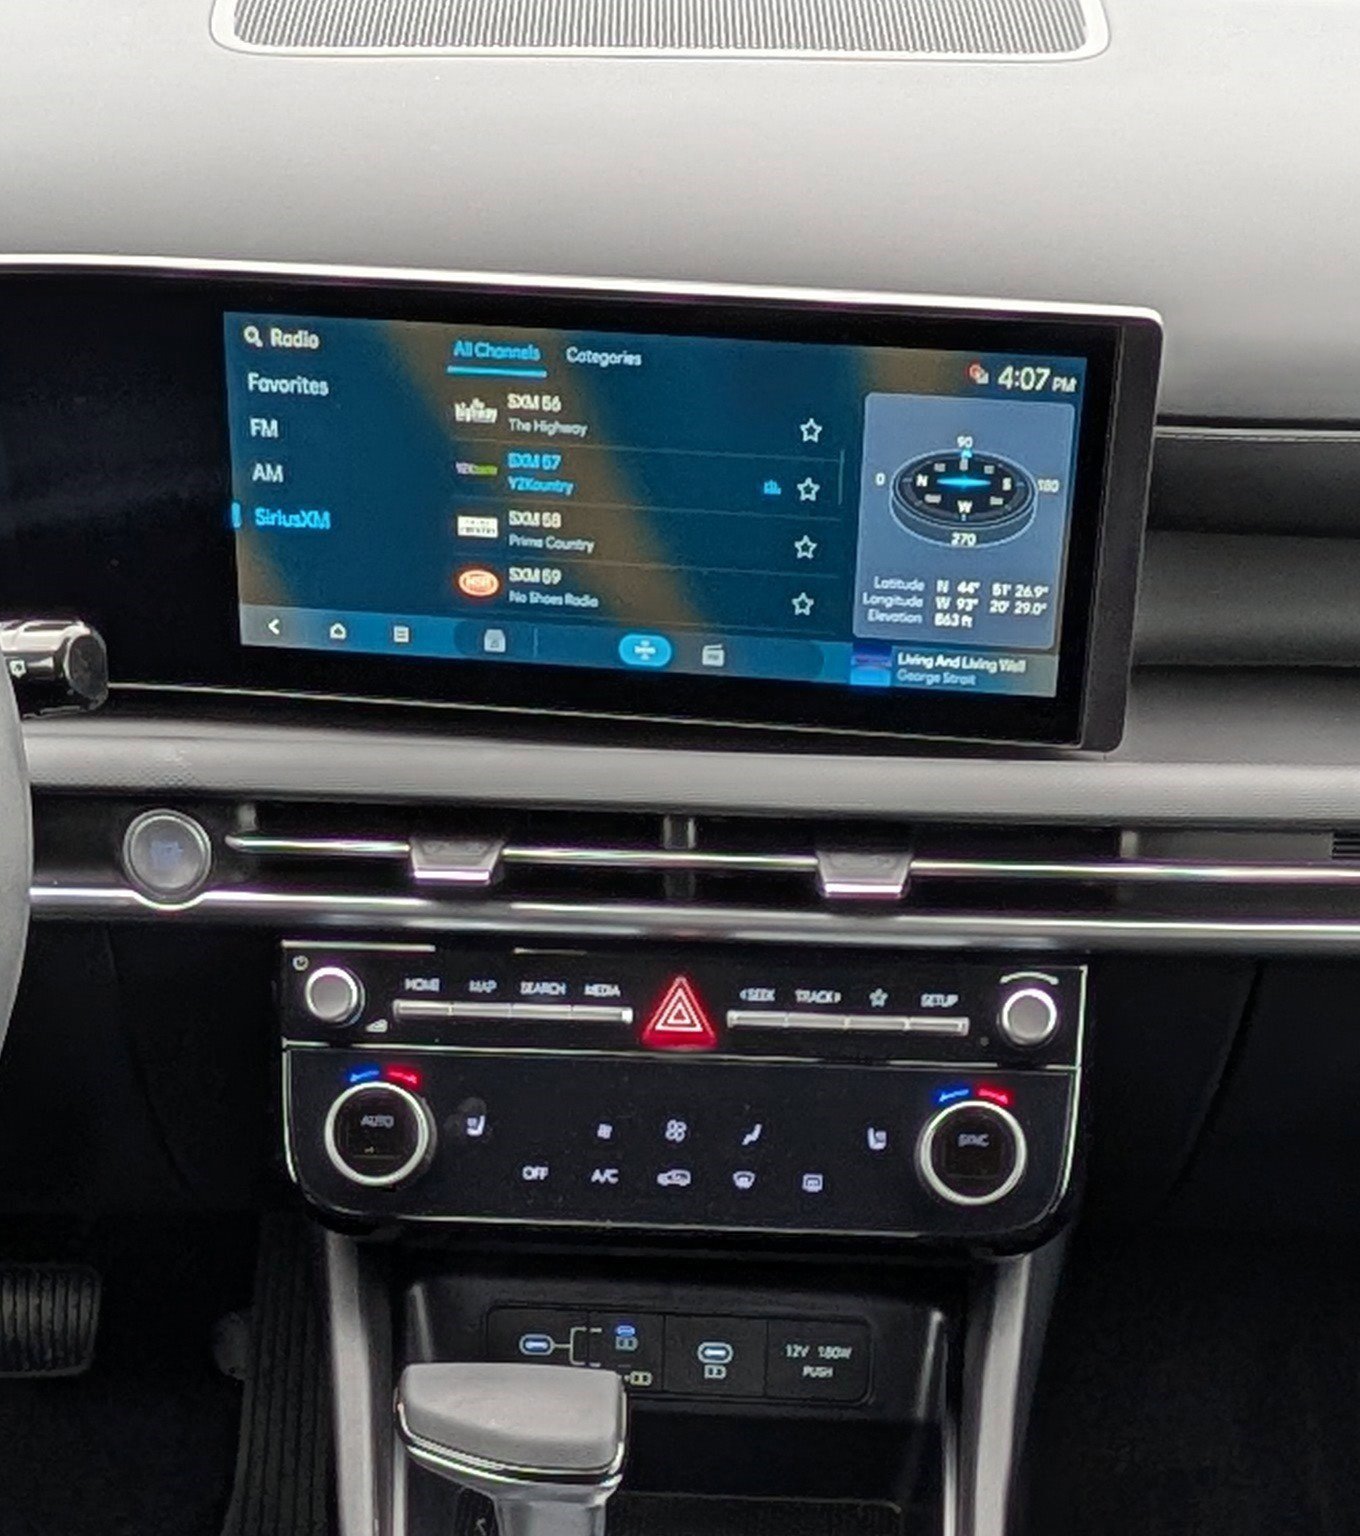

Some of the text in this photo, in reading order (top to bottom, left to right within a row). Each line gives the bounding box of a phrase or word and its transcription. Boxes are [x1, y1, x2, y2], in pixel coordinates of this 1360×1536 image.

[270, 329, 319, 350] Radio
[453, 340, 540, 360] All Channels
[566, 347, 642, 368] Categories
[247, 373, 329, 397] Favorites
[998, 366, 1077, 393] 4:07 PM
[507, 394, 539, 410] SXM
[250, 418, 278, 439] FM
[509, 418, 588, 438] The Highway
[508, 453, 539, 469] SXM
[252, 463, 283, 483] AM
[254, 507, 330, 530] SiriusXM
[509, 510, 540, 526] SXM
[545, 536, 594, 553] Country
[951, 532, 976, 546] 270
[509, 568, 540, 583] SXM
[874, 576, 925, 592] Latitude
[565, 593, 598, 608] Radio
[863, 593, 923, 609] Longitude
[867, 609, 923, 623] Elevation
[897, 652, 933, 670] Living
[935, 654, 960, 669] And
[404, 978, 620, 997] HOME MAP SEARCH MEDIA
[921, 993, 958, 1008] SETUP
[522, 1166, 549, 1182] OFF
[591, 1168, 619, 1184] A/C
[785, 1344, 809, 1359] 12V
[802, 1365, 833, 1379] PUSH
